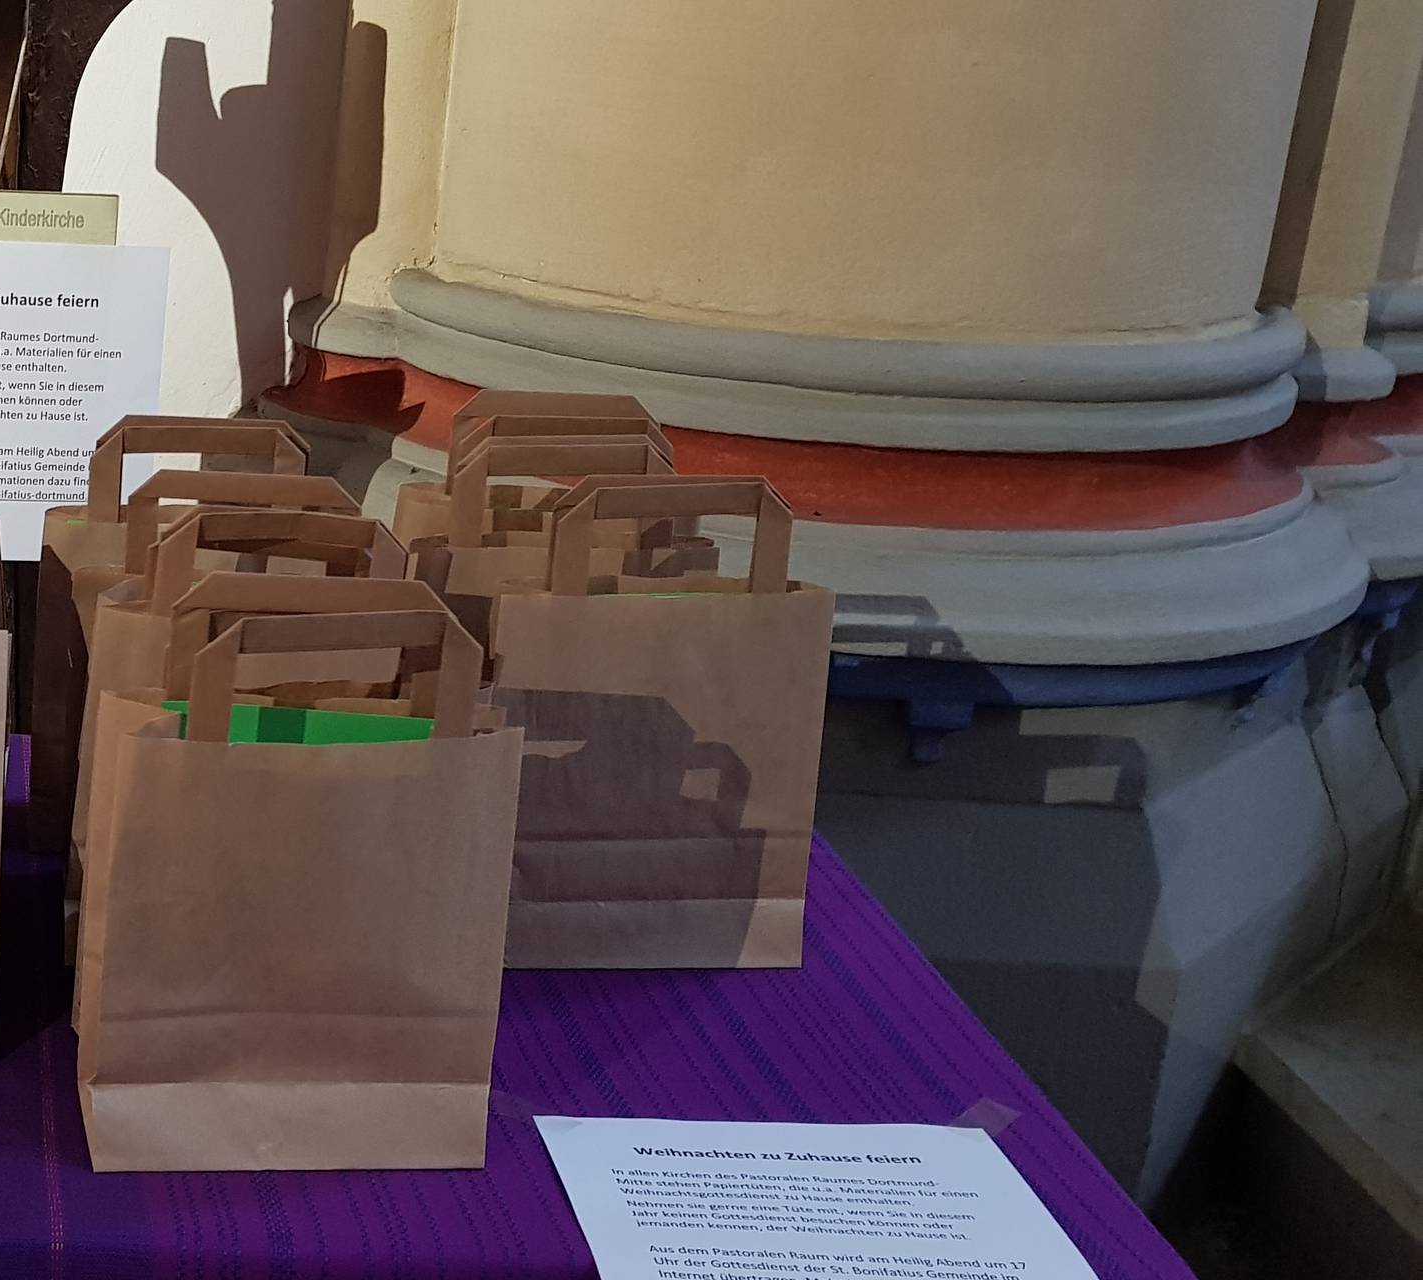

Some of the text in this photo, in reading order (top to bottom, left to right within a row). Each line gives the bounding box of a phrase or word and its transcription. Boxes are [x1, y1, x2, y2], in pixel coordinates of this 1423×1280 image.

[57, 294, 98, 307] feiern
[0, 330, 40, 341] Raumes
[43, 332, 98, 343] Dortmund-
[15, 346, 73, 357] Materialien
[76, 348, 91, 357] für
[93, 348, 121, 358] einen
[14, 361, 66, 372] enthalten.
[38, 380, 53, 390] Sie
[56, 381, 65, 390] in
[68, 381, 103, 392] diesem
[18, 395, 56, 405] können
[58, 396, 82, 406] oder
[40, 410, 71, 420] Hause
[73, 411, 87, 421] ist.
[16, 446, 44, 458] Heilig
[46, 446, 78, 456] Abend
[34, 461, 85, 471] Gemeinde
[47, 475, 70, 485] dazu
[634, 1147, 755, 1158] Weihnachten
[785, 1151, 862, 1162] Zuhause
[866, 1154, 921, 1164] feiern
[648, 1244, 674, 1253] Aus
[677, 1245, 709, 1254] dem
[712, 1247, 786, 1258] Pastoralen
[789, 1251, 829, 1260] Raum
[832, 1253, 864, 1261] wird
[892, 1255, 933, 1267] Heilig
[935, 1257, 980, 1267] Abend
[1010, 1261, 1027, 1269] 17
[654, 1256, 680, 1265] Uhr
[682, 1257, 707, 1266] der
[710, 1259, 799, 1271] Gottesdienst
[802, 1263, 827, 1272] der
[830, 1264, 848, 1273] St.
[852, 1266, 923, 1277] Bonifatius
[925, 1269, 998, 1280] Gemeinde
[658, 1270, 715, 1280] Internet
